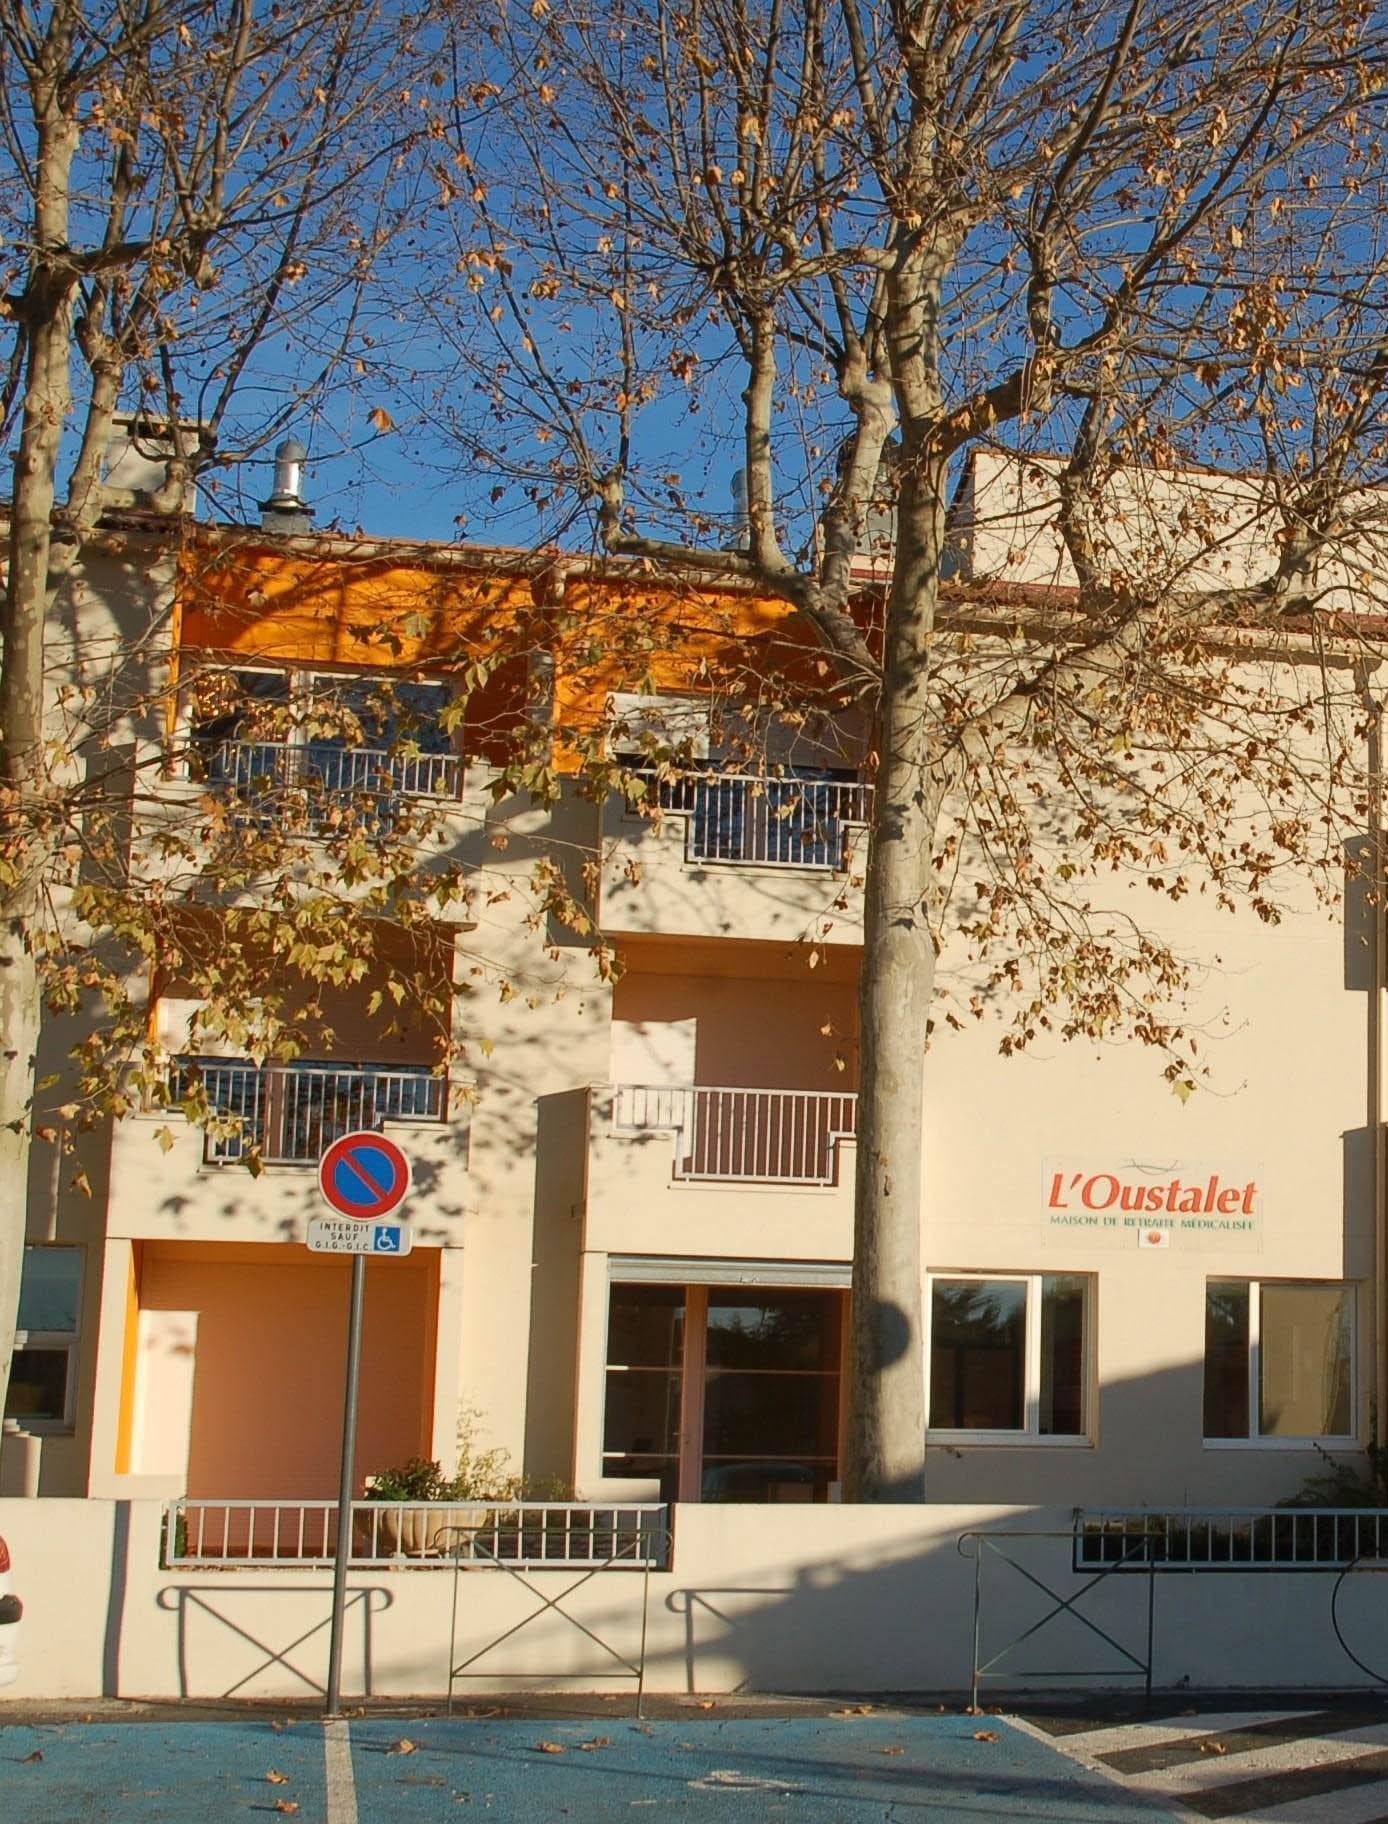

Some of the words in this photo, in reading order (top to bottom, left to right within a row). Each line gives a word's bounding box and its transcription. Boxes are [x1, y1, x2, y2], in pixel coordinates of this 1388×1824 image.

[1048, 1173, 1258, 1216] L'Oustalet
[1050, 1216, 1098, 1226] MAISON
[1104, 1216, 1117, 1227] DE
[320, 1222, 369, 1232] INTERDIT
[331, 1232, 359, 1241] SAUF
